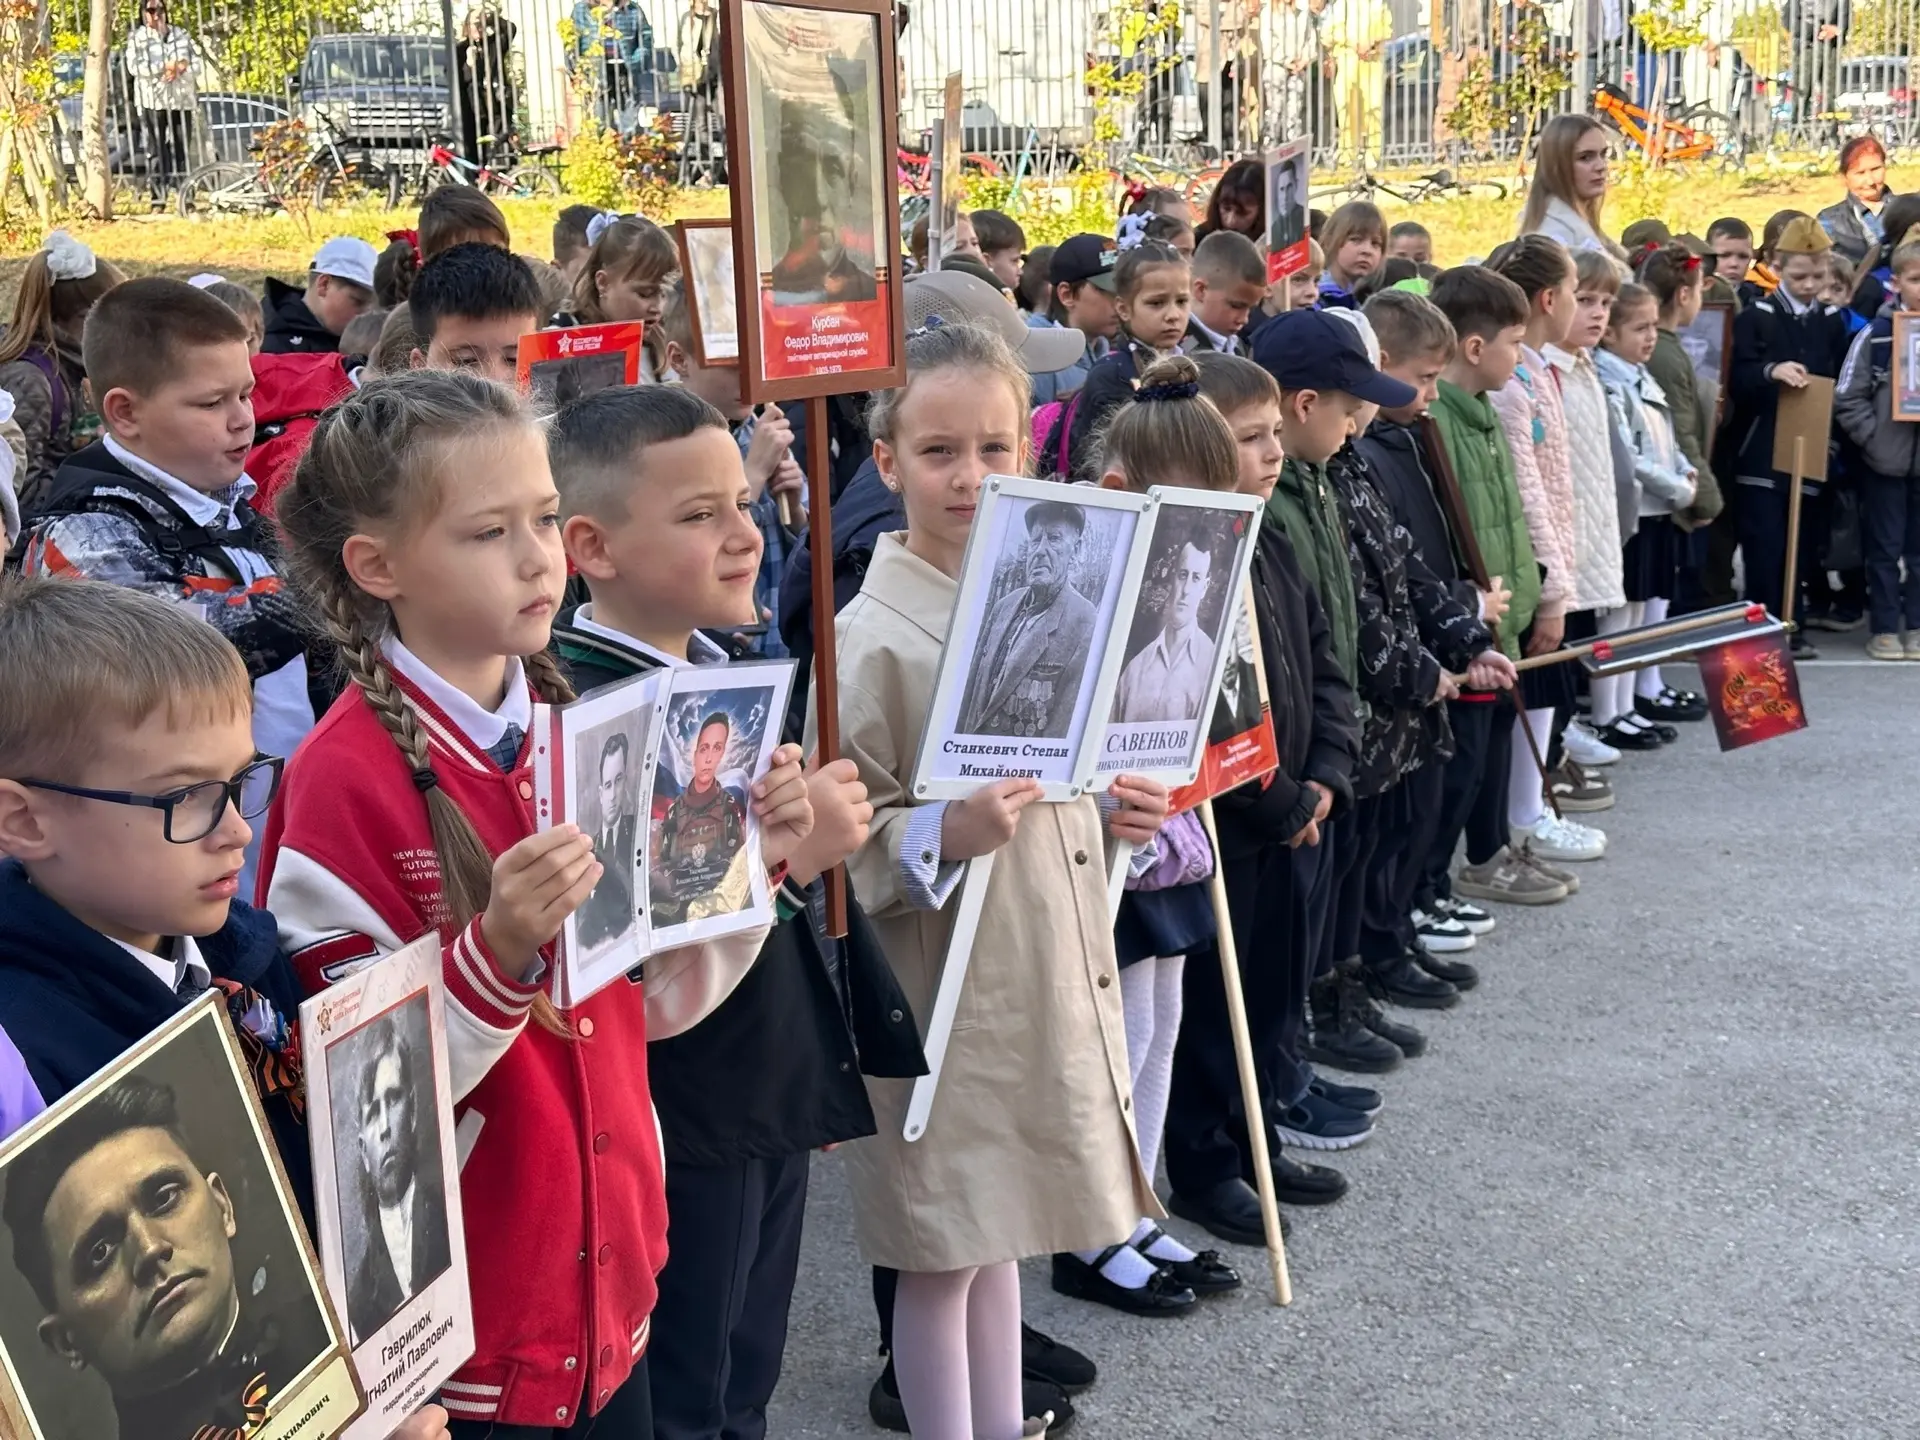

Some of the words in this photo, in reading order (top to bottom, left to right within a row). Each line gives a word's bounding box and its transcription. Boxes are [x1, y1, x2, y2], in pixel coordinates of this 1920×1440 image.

[811, 316, 840, 332] Курбан
[784, 336, 811, 350] Федор
[811, 332, 869, 347] Владимирович
[943, 740, 1018, 756] Станкевич
[1022, 744, 1069, 758] Степан
[1106, 730, 1189, 753] САВЕНКОВ
[959, 764, 1043, 778] Михайлович
[392, 849, 414, 860] NEW
[381, 1310, 432, 1366] Гаврилюк
[407, 1315, 453, 1369] Павлович
